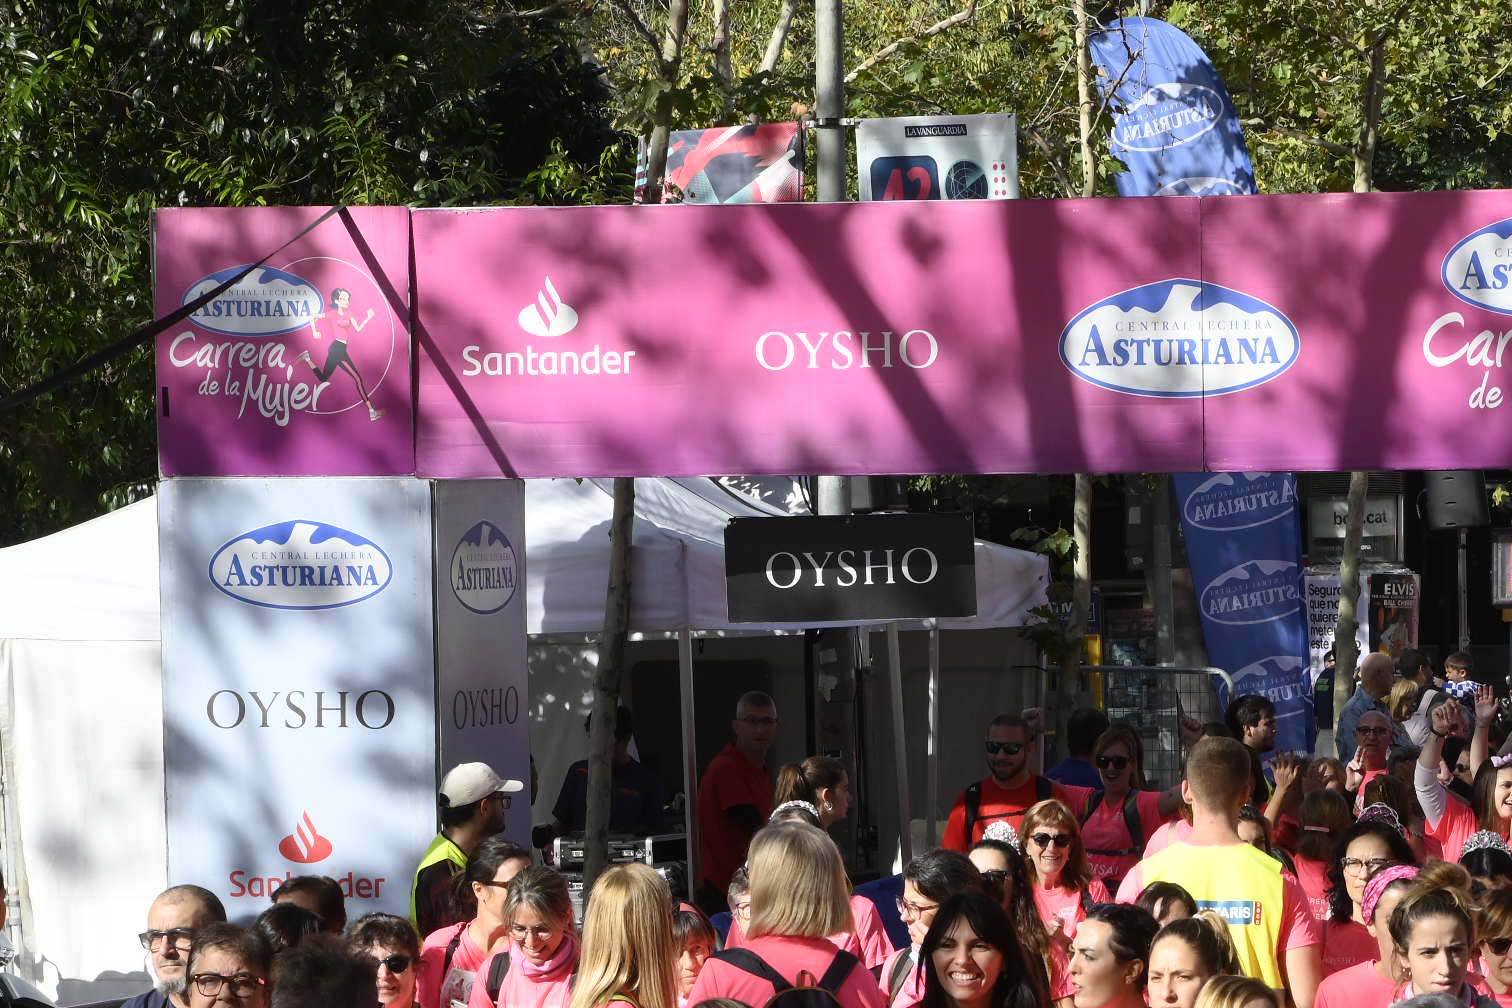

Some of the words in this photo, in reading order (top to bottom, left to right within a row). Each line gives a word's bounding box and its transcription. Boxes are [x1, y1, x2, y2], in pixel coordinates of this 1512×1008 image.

[917, 125, 966, 136] VANGUARDIA
[1115, 321, 1188, 331] CENTRAL
[169, 331, 286, 368] Carrera
[462, 345, 636, 376] Santander
[755, 328, 939, 370] OYSHO
[1079, 324, 1281, 367] ASTURIANA
[198, 370, 220, 396] de
[225, 371, 240, 396] la
[238, 366, 331, 427] Mujer
[1469, 371, 1505, 410] de
[223, 553, 380, 588] ASTURIANA
[251, 551, 308, 560] CENTRAL
[315, 551, 374, 560] LECHERA
[765, 547, 938, 589] OYSHO
[456, 563, 514, 591] ASTURIANA
[1384, 583, 1414, 596] ELVIS
[1310, 612, 1342, 625] quiere
[1310, 624, 1336, 635] mete
[1310, 638, 1330, 650] este
[206, 689, 396, 730] OYSHO
[453, 686, 519, 730] OYSHO
[229, 870, 386, 899] Sander
